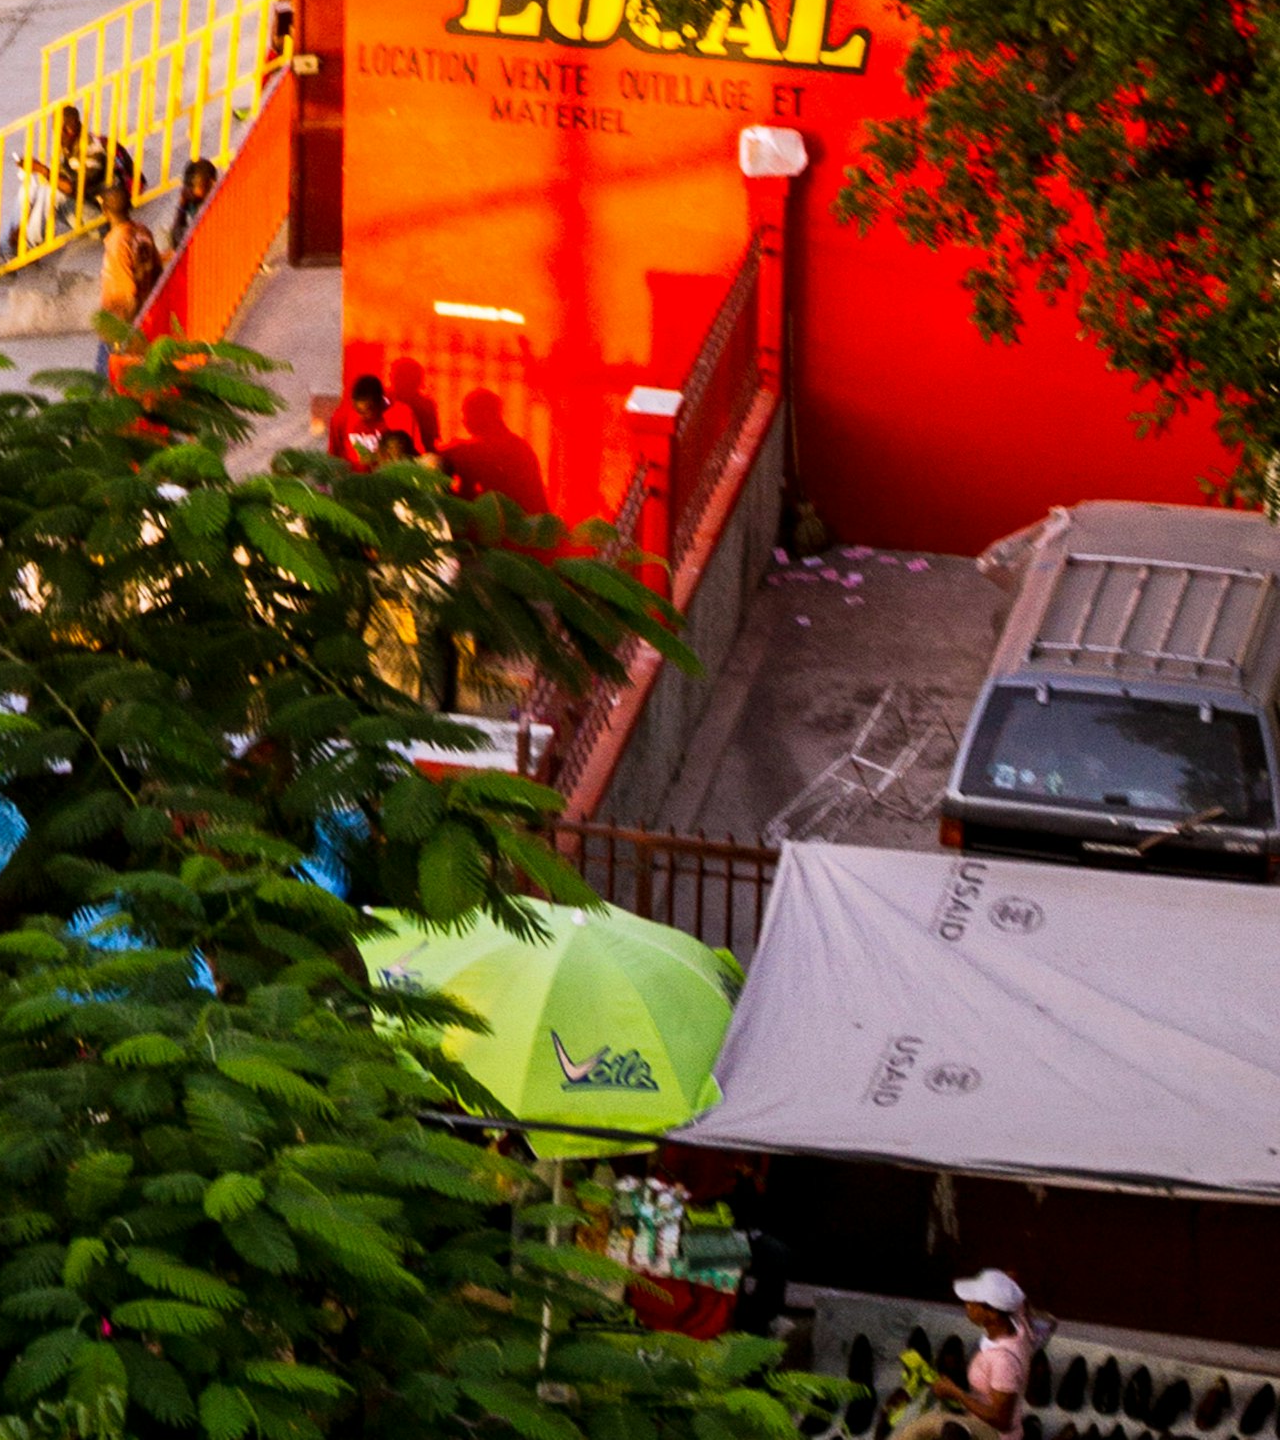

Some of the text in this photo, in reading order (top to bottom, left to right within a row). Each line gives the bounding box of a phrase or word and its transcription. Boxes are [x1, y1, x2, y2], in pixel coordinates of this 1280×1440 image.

[358, 43, 479, 86] LOCATION
[498, 55, 589, 97] VENTE
[773, 83, 806, 118] ET
[490, 94, 631, 136] MATERIEL
[939, 860, 989, 942] USAID
[873, 1034, 924, 1109] USAID
